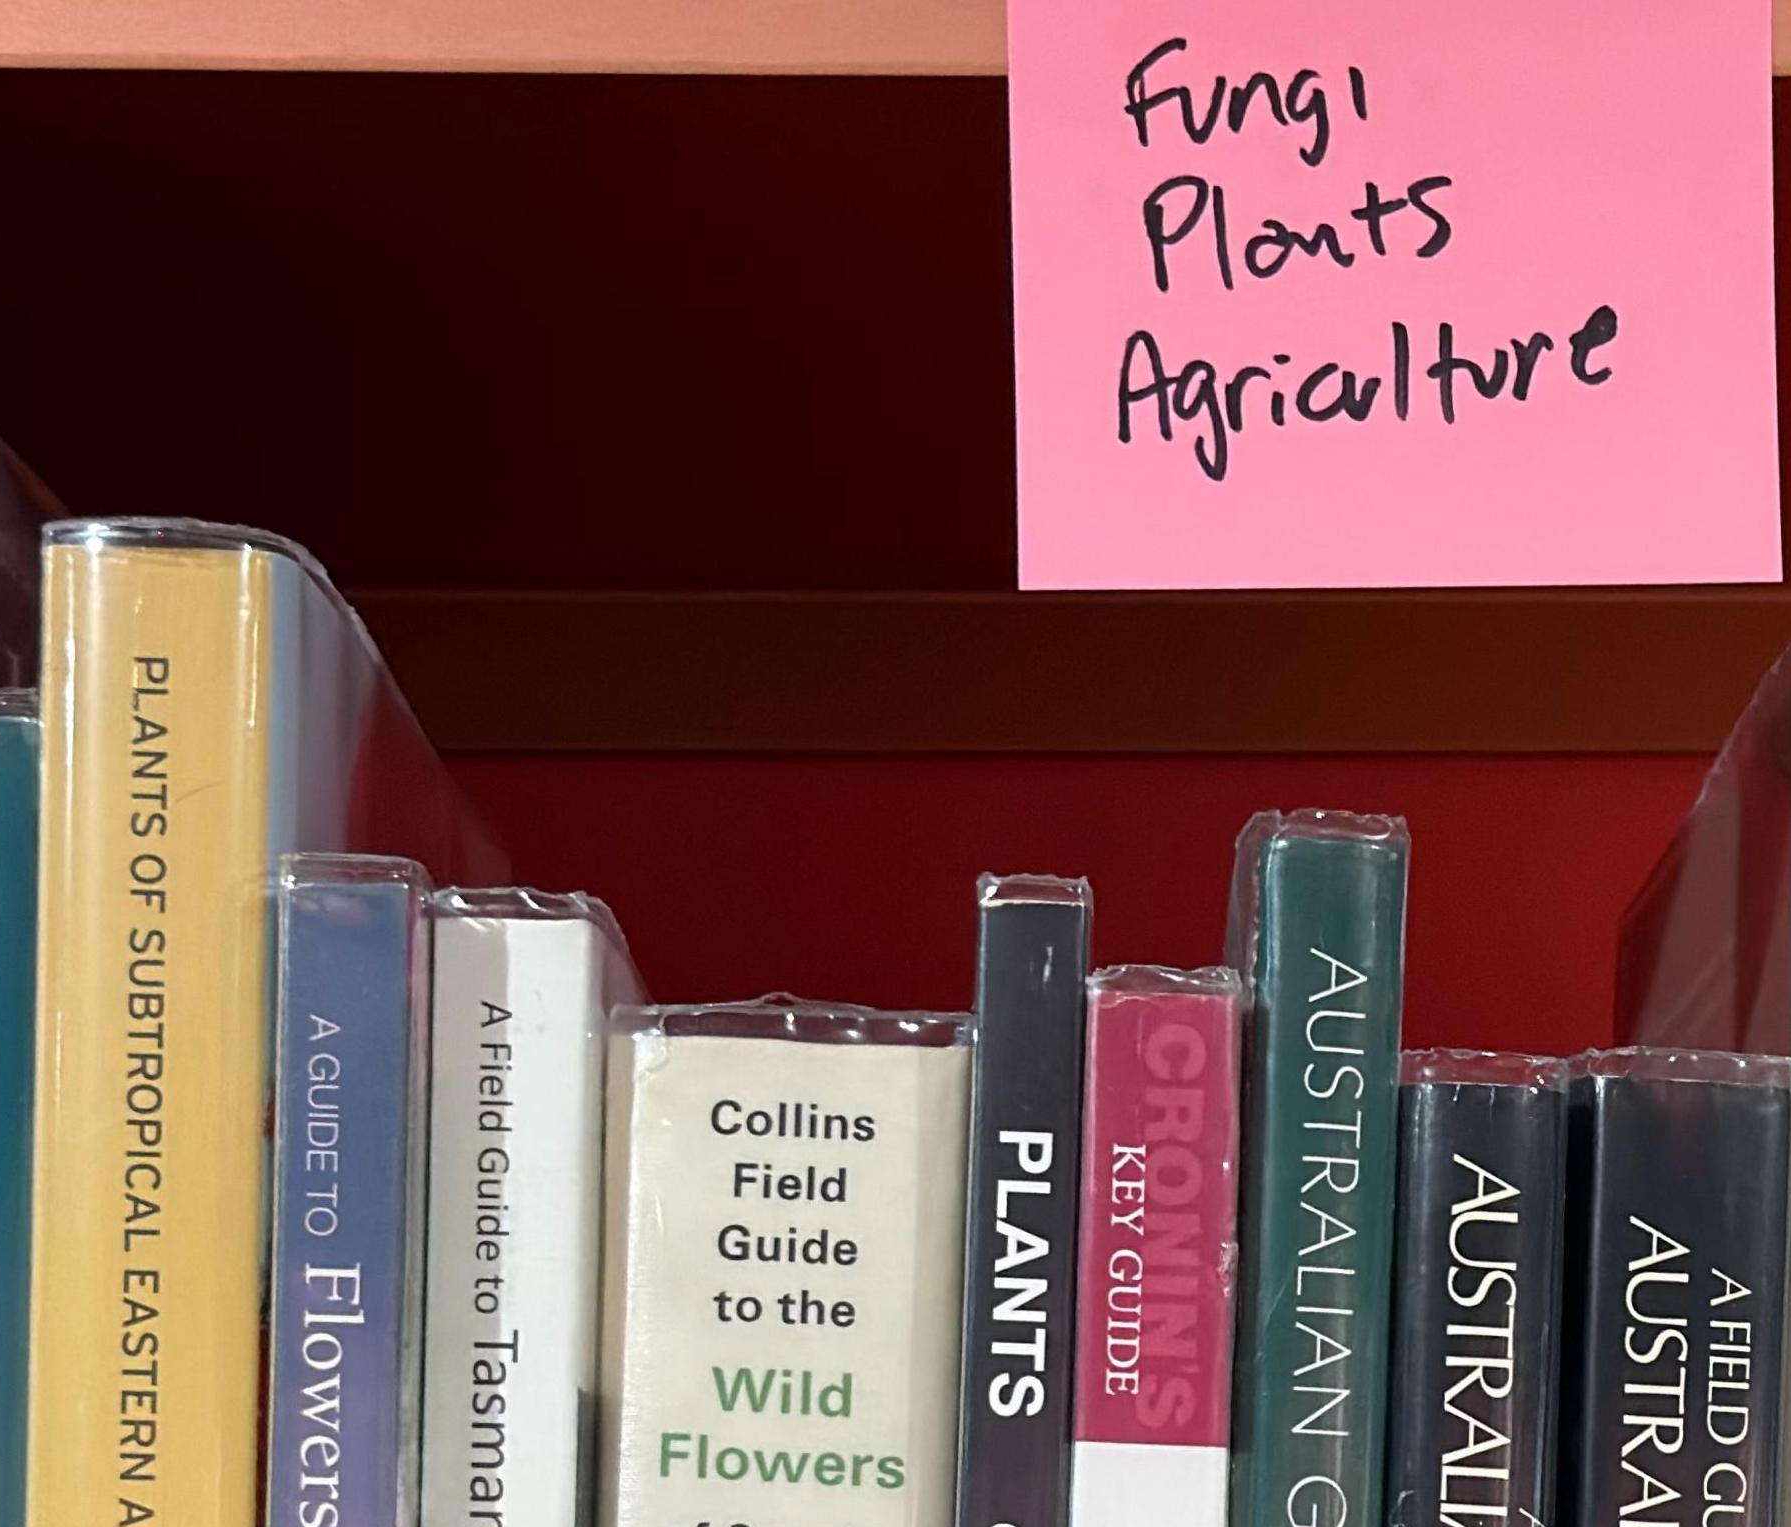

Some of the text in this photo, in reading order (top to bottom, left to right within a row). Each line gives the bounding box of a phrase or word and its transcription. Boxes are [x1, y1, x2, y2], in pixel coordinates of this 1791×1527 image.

[1124, 37, 1368, 167] Fungi
[1144, 175, 1452, 291] Plants
[1117, 305, 1617, 481] Agriculture
[131, 655, 170, 839] PLANTS
[129, 854, 166, 915] OF
[310, 1014, 340, 1041] A
[481, 999, 513, 1028] A
[122, 929, 167, 1252] SUBTROPICAL
[307, 1053, 341, 1172] GUIDE
[479, 1042, 512, 1132] Field
[710, 1100, 876, 1144] Collins
[304, 1182, 338, 1238] TO
[476, 1147, 510, 1261] Guide
[733, 1162, 848, 1203] Field
[1291, 947, 1369, 1437] AUSTRALIAN
[717, 1225, 859, 1267] Guide
[988, 1130, 1053, 1418] PLANTS
[1105, 1143, 1147, 1397] KEY GUIDE
[1710, 1268, 1752, 1306] A
[474, 1276, 505, 1315] to
[713, 1288, 857, 1328] to the
[119, 1268, 161, 1482] EASTERN
[712, 1367, 853, 1418] Wild
[1707, 1319, 1751, 1446] FIELD
[659, 1433, 906, 1491] Flowers
